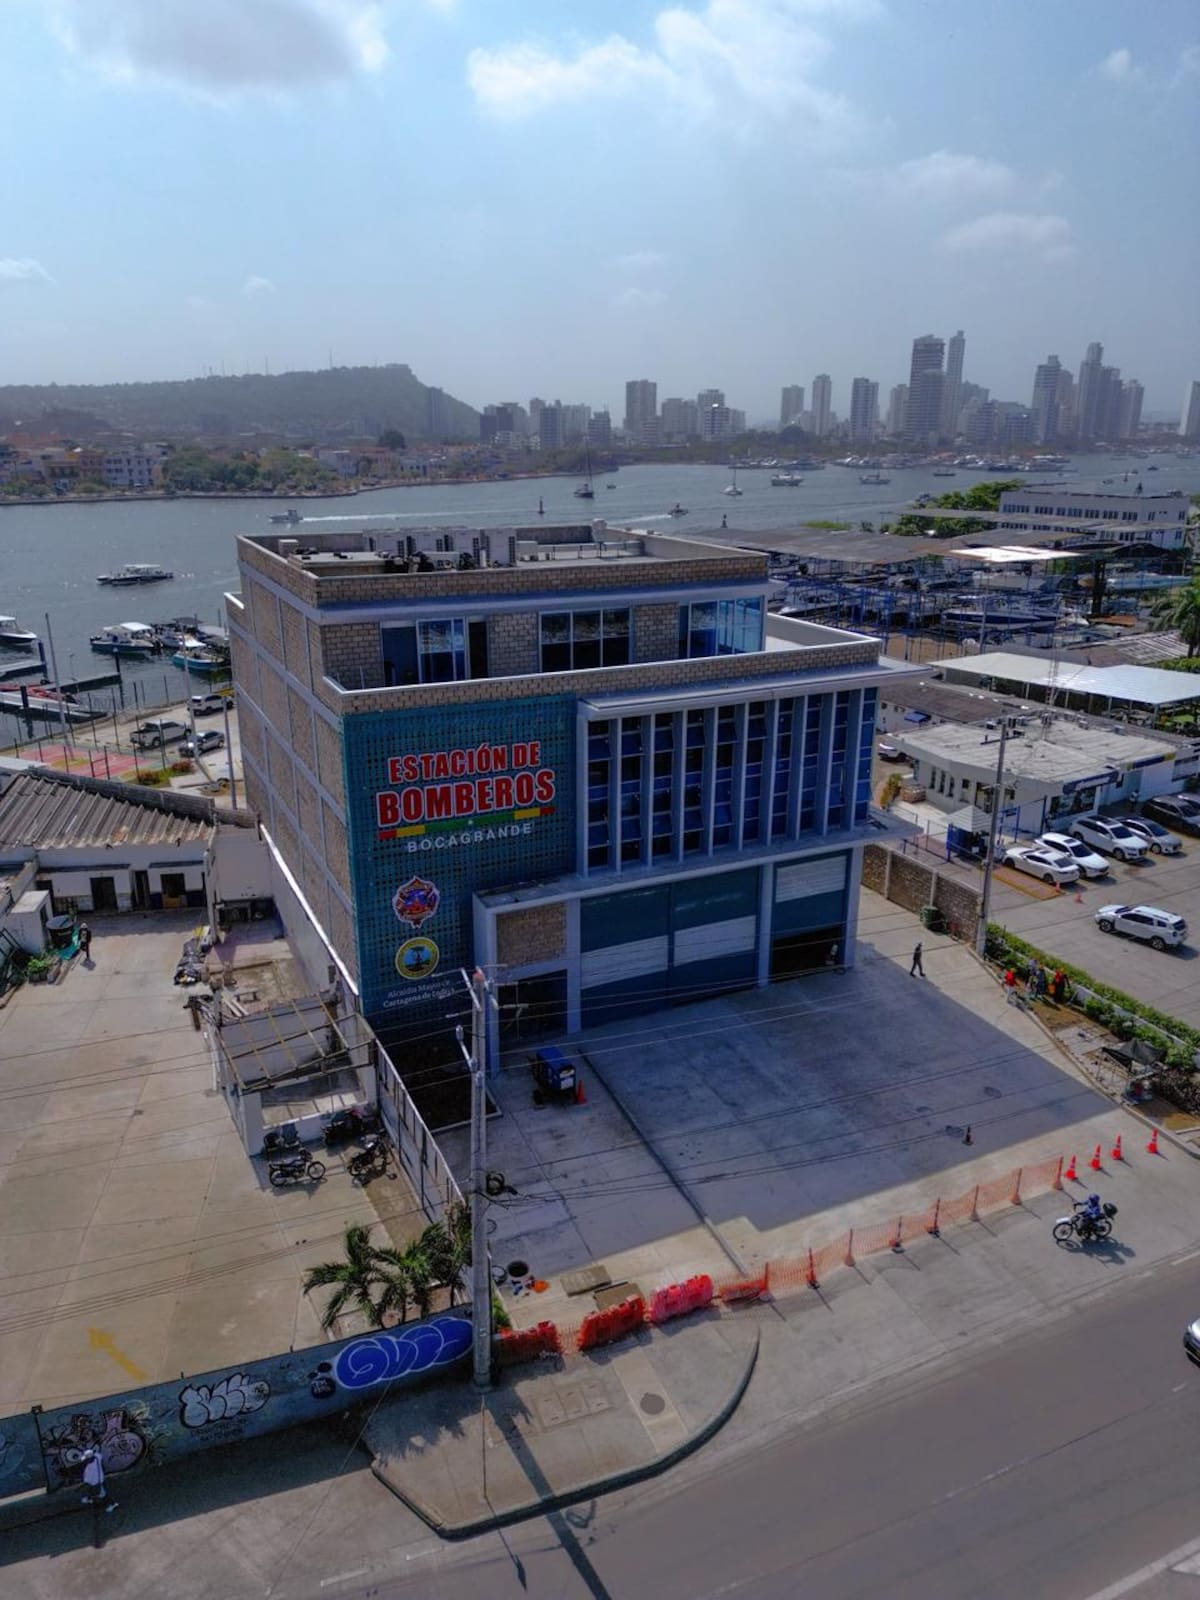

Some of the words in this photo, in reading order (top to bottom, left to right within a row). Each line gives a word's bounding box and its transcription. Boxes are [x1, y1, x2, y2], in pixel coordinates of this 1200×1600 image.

[388, 743, 507, 783] ESTACIÓN
[512, 741, 541, 768] DE
[377, 770, 555, 827] BOMBEROS
[407, 822, 532, 853] BOCAGRANDE
